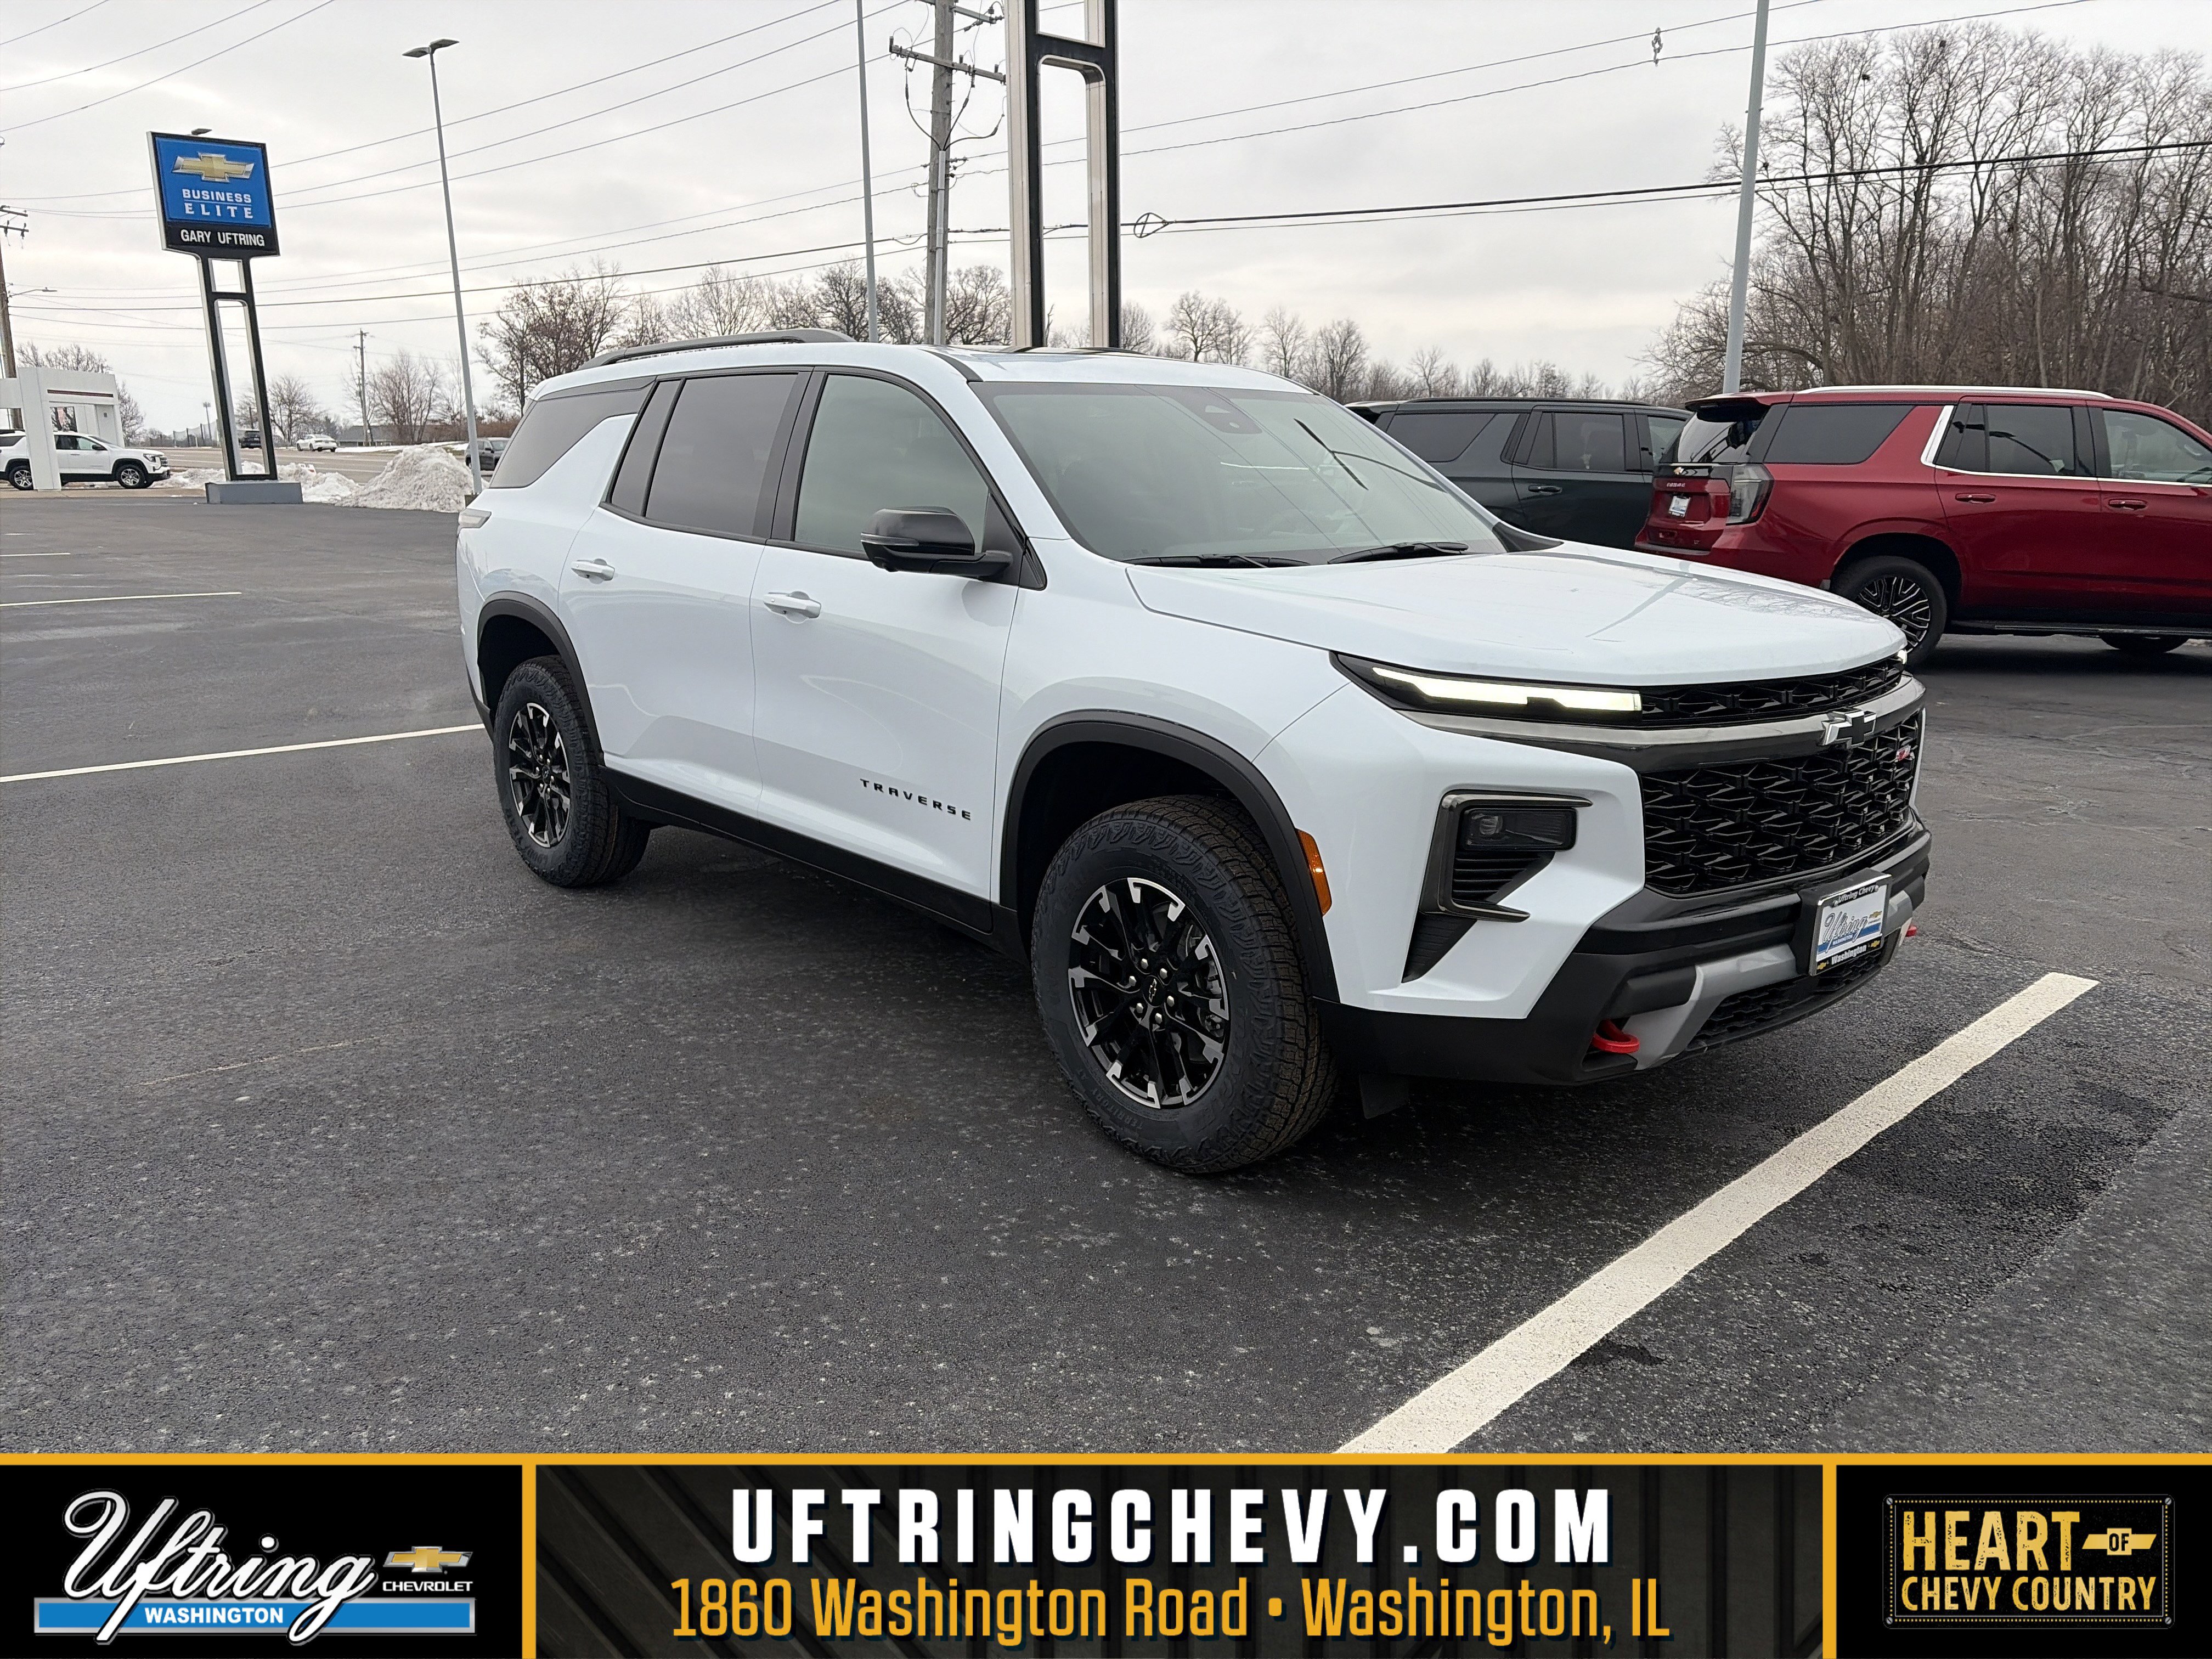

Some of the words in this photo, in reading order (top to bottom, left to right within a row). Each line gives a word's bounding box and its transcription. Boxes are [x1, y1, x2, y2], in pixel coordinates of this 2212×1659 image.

[182, 189, 252, 203] BUSINESS
[184, 202, 253, 219] ELITE
[180, 229, 211, 243] GARY
[217, 232, 265, 247] UFTRING
[860, 778, 971, 821] TRAVERSE
[1838, 891, 1858, 903] Uftring
[1858, 884, 1876, 895] Chevy
[1831, 944, 1867, 965] Washington
